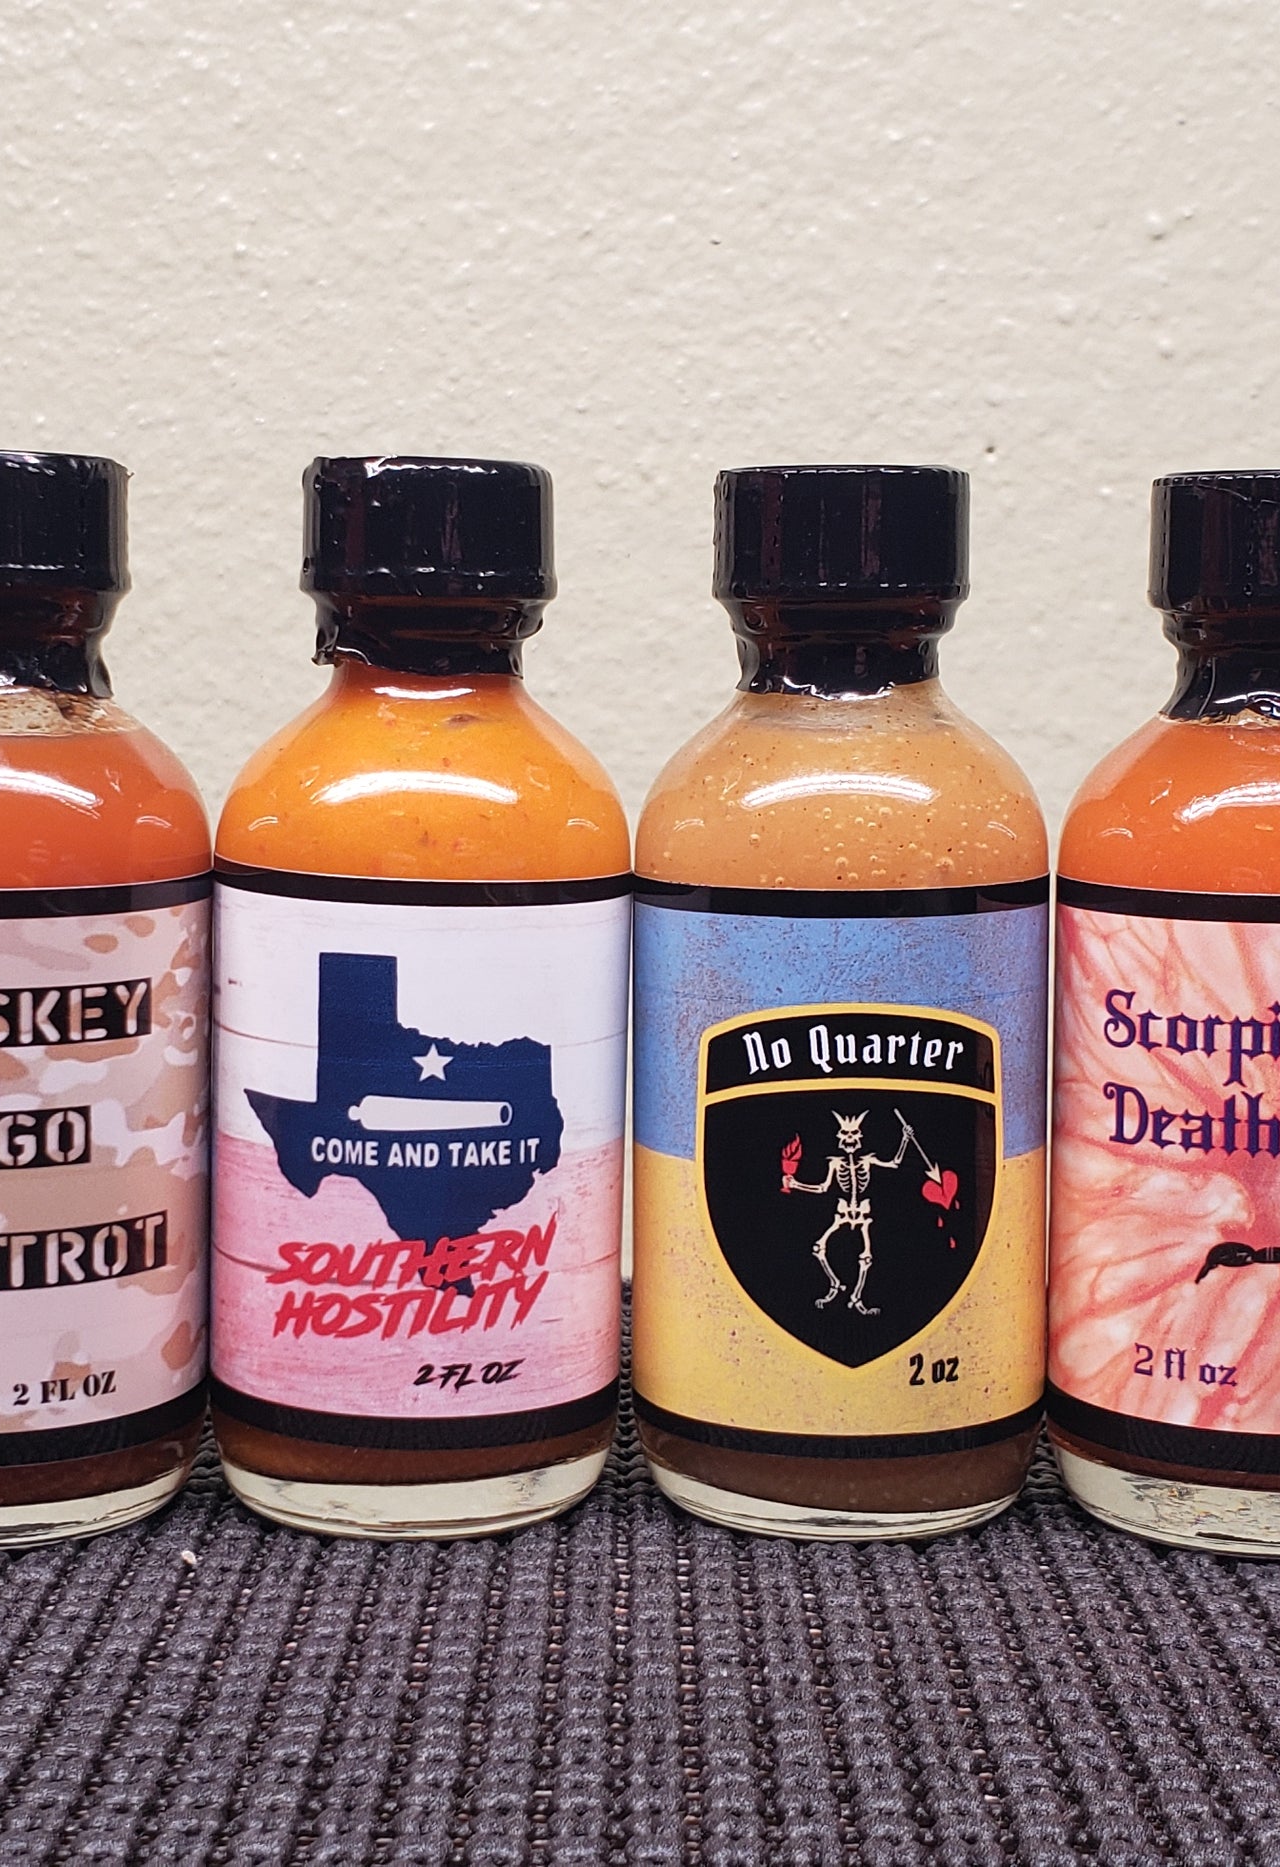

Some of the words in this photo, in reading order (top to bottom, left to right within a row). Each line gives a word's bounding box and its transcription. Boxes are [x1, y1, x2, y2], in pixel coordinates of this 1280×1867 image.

[741, 1029, 792, 1077] No
[809, 1023, 964, 1075] Quarter
[310, 1136, 380, 1168] COME
[387, 1140, 441, 1168] AND
[448, 1138, 513, 1168] TAKE
[519, 1136, 541, 1166] IT
[266, 1211, 558, 1290] SOUTHERN
[272, 1272, 549, 1340] HOSTILITY
[412, 1363, 434, 1389] 2
[434, 1361, 477, 1393] FL
[479, 1357, 526, 1384] OZ
[908, 1353, 926, 1387] 2
[931, 1356, 960, 1384] oz
[1132, 1343, 1155, 1377] 2
[1162, 1346, 1188, 1383] fl
[1197, 1361, 1239, 1389] oz
[11, 1382, 31, 1408] 2
[39, 1375, 79, 1405] FL
[82, 1370, 118, 1398] OZ
